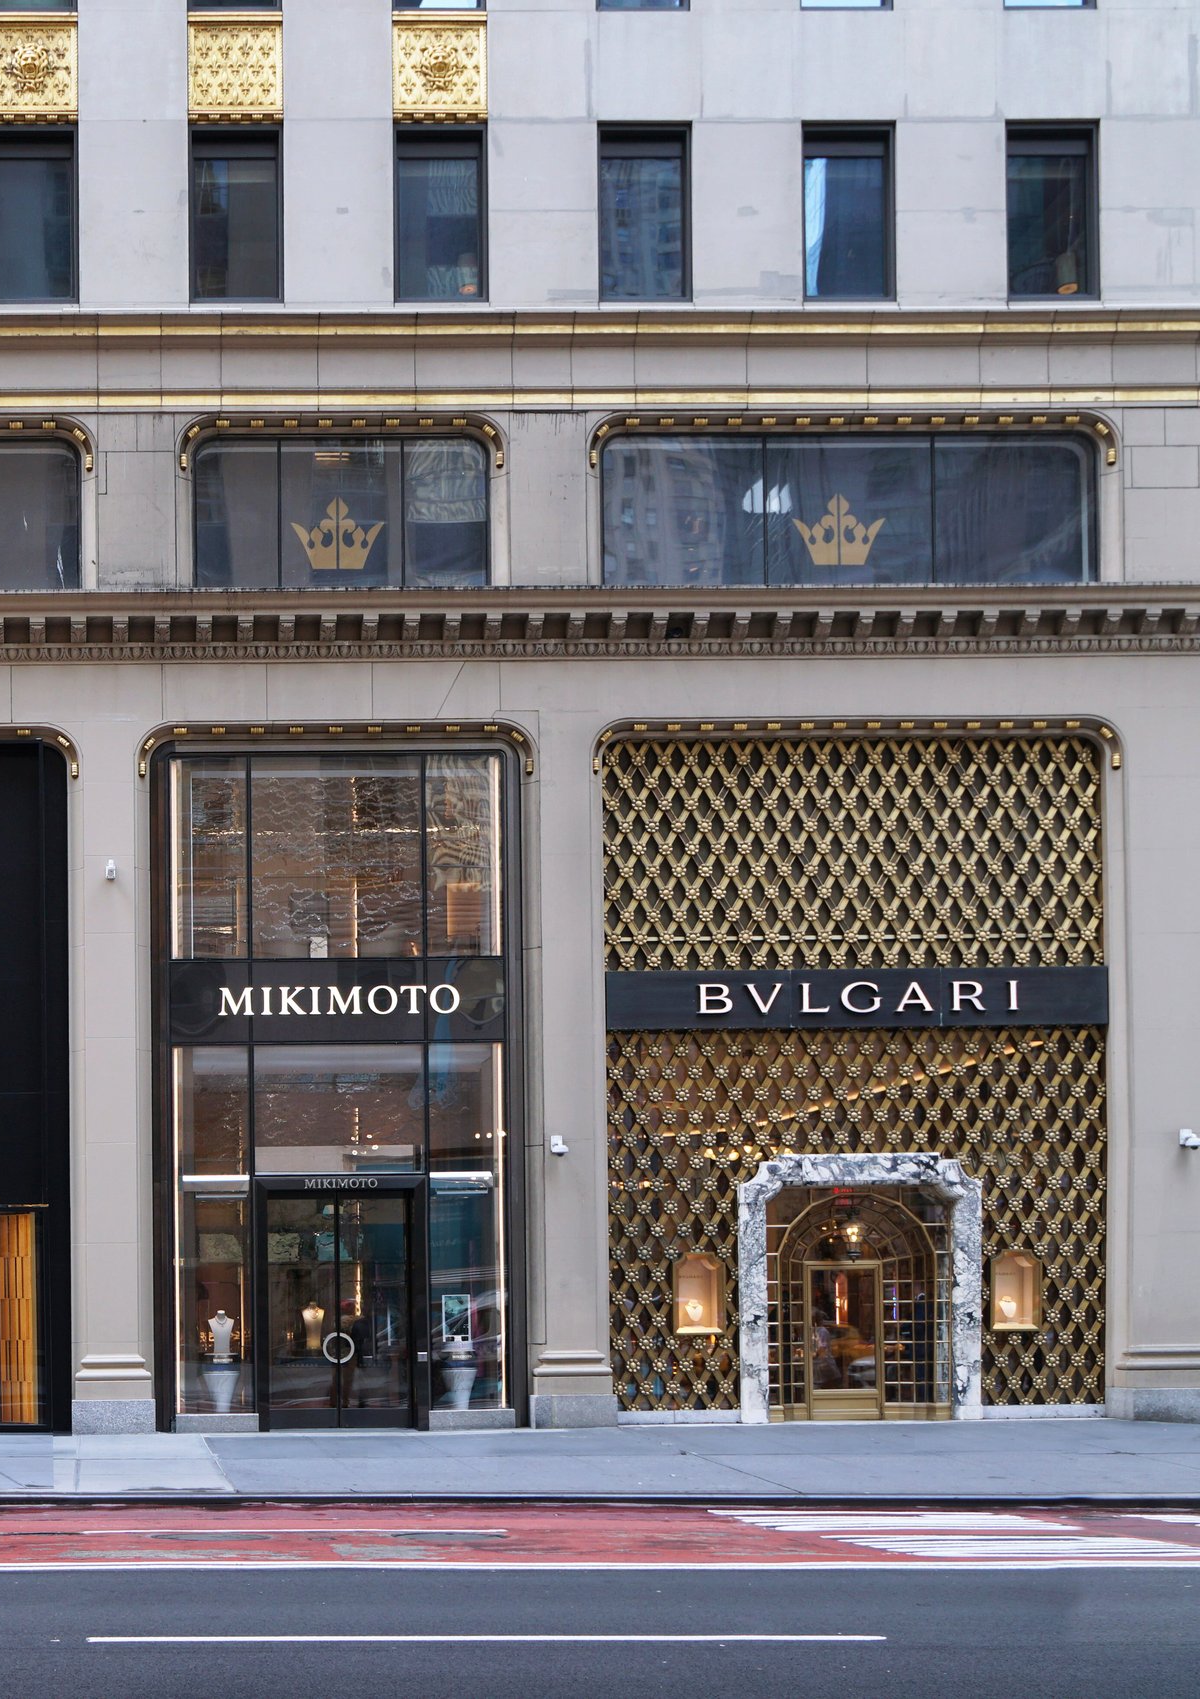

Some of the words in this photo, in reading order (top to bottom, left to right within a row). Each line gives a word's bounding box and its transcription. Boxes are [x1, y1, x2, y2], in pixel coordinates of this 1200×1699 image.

[218, 984, 460, 1016] MIKIMOTO
[697, 980, 1019, 1014] BVLGARI
[304, 1178, 378, 1189] MIKIMOTO
